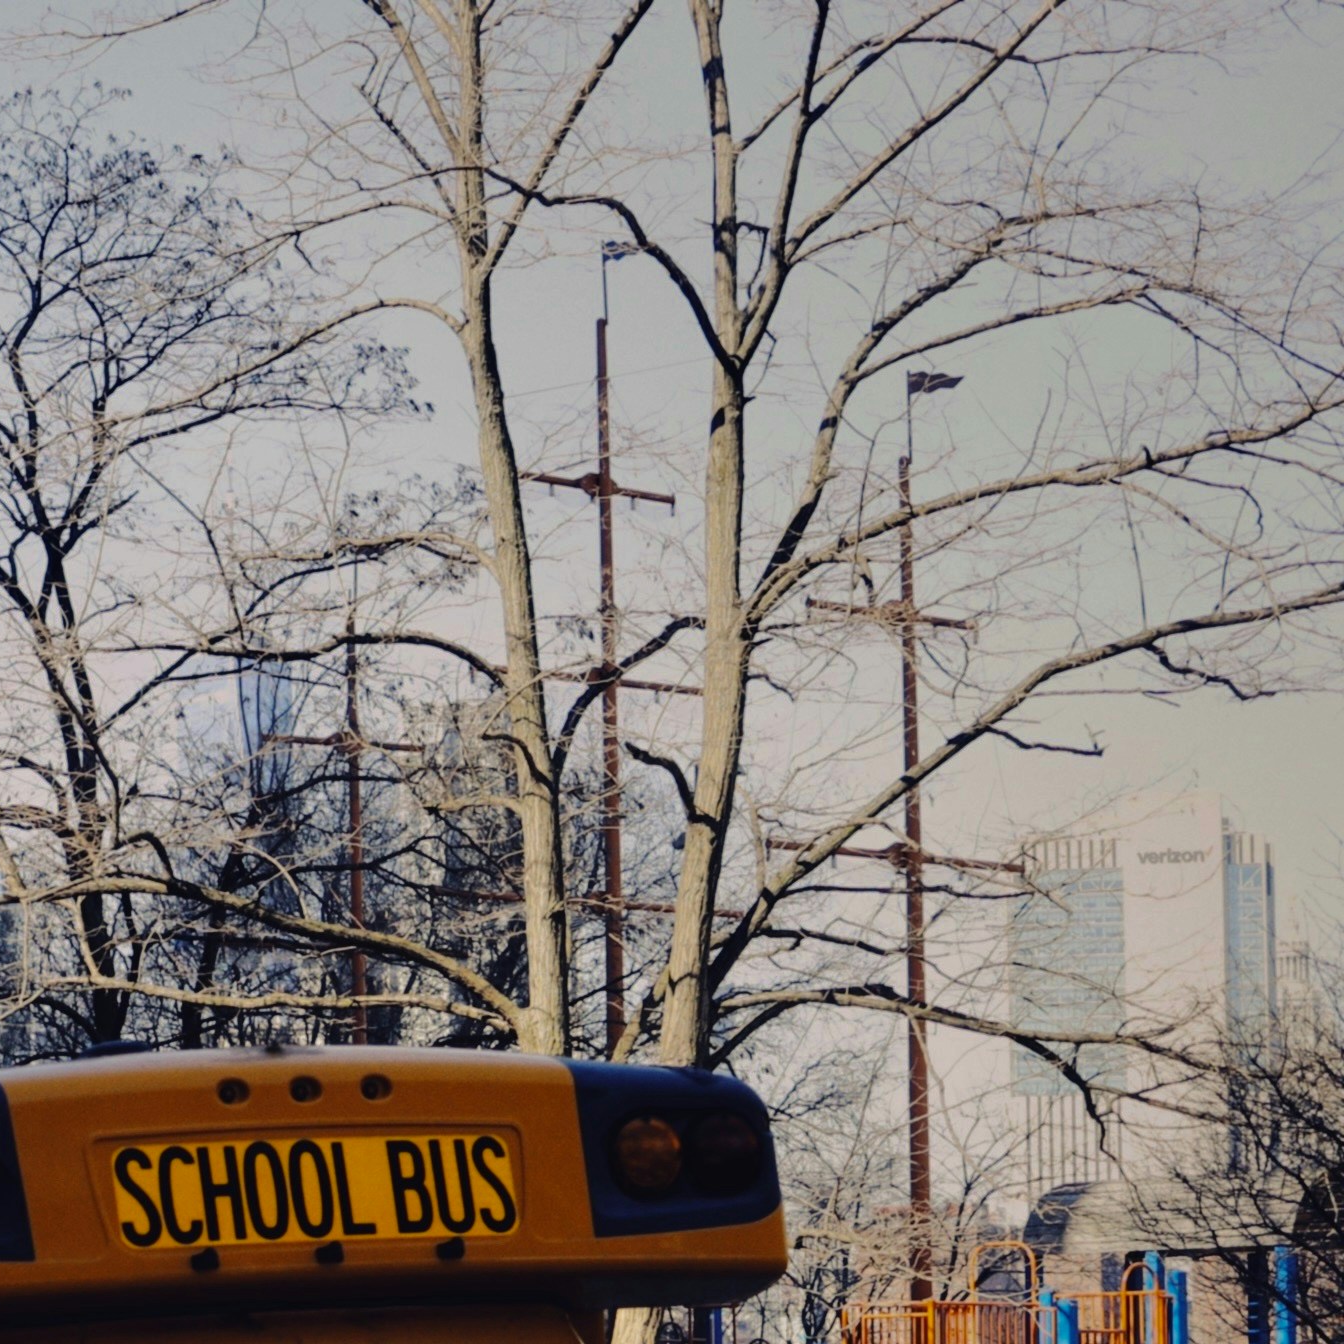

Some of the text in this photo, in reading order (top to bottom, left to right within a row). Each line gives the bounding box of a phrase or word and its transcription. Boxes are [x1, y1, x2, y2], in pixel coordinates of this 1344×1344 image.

[1136, 848, 1205, 864] verizon
[114, 1136, 516, 1246] SCHOOL BUS
